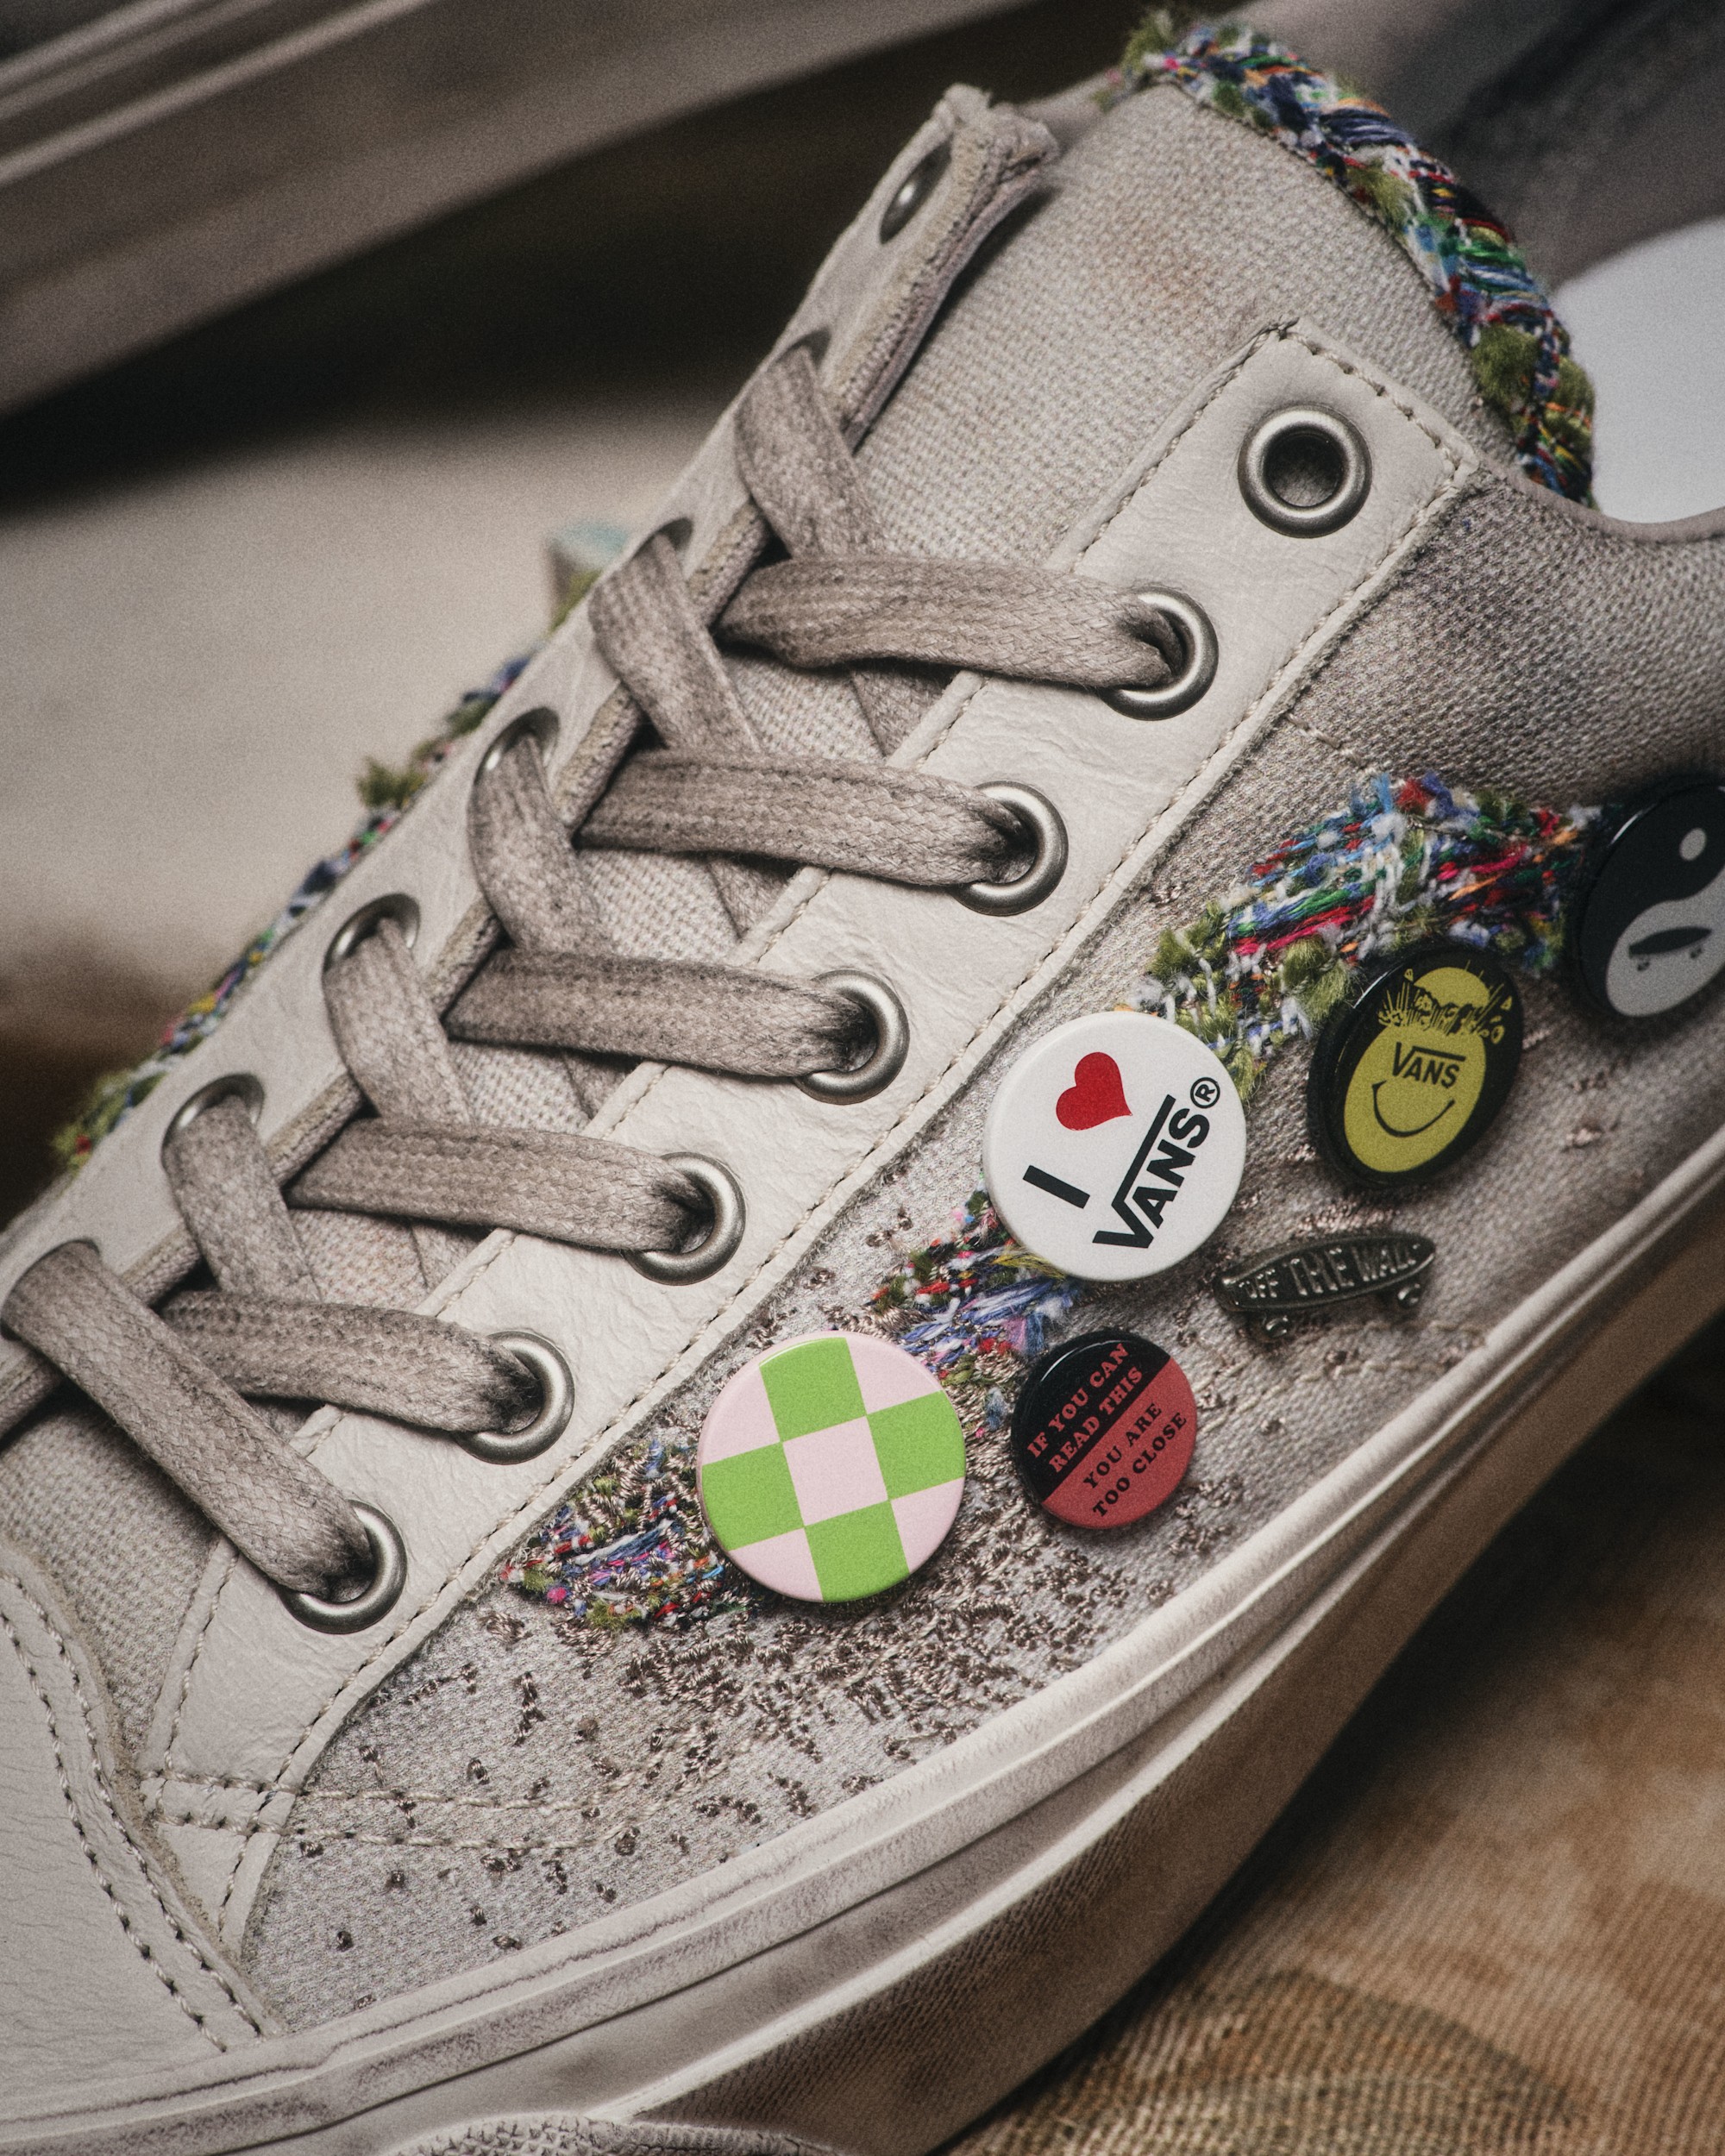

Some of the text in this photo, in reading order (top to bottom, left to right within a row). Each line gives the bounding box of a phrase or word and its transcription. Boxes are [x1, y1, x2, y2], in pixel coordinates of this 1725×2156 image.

[1392, 1042, 1465, 1088] VANS
[1023, 1165, 1090, 1209] I
[1282, 1247, 1355, 1295] THE
[1351, 1243, 1420, 1283] WALL
[1026, 1343, 1129, 1458] IF YOU CAN
[1049, 1366, 1143, 1473] READ THIS
[1083, 1403, 1162, 1489] YOU ARE
[1092, 1412, 1187, 1517] TOO CLOSE
